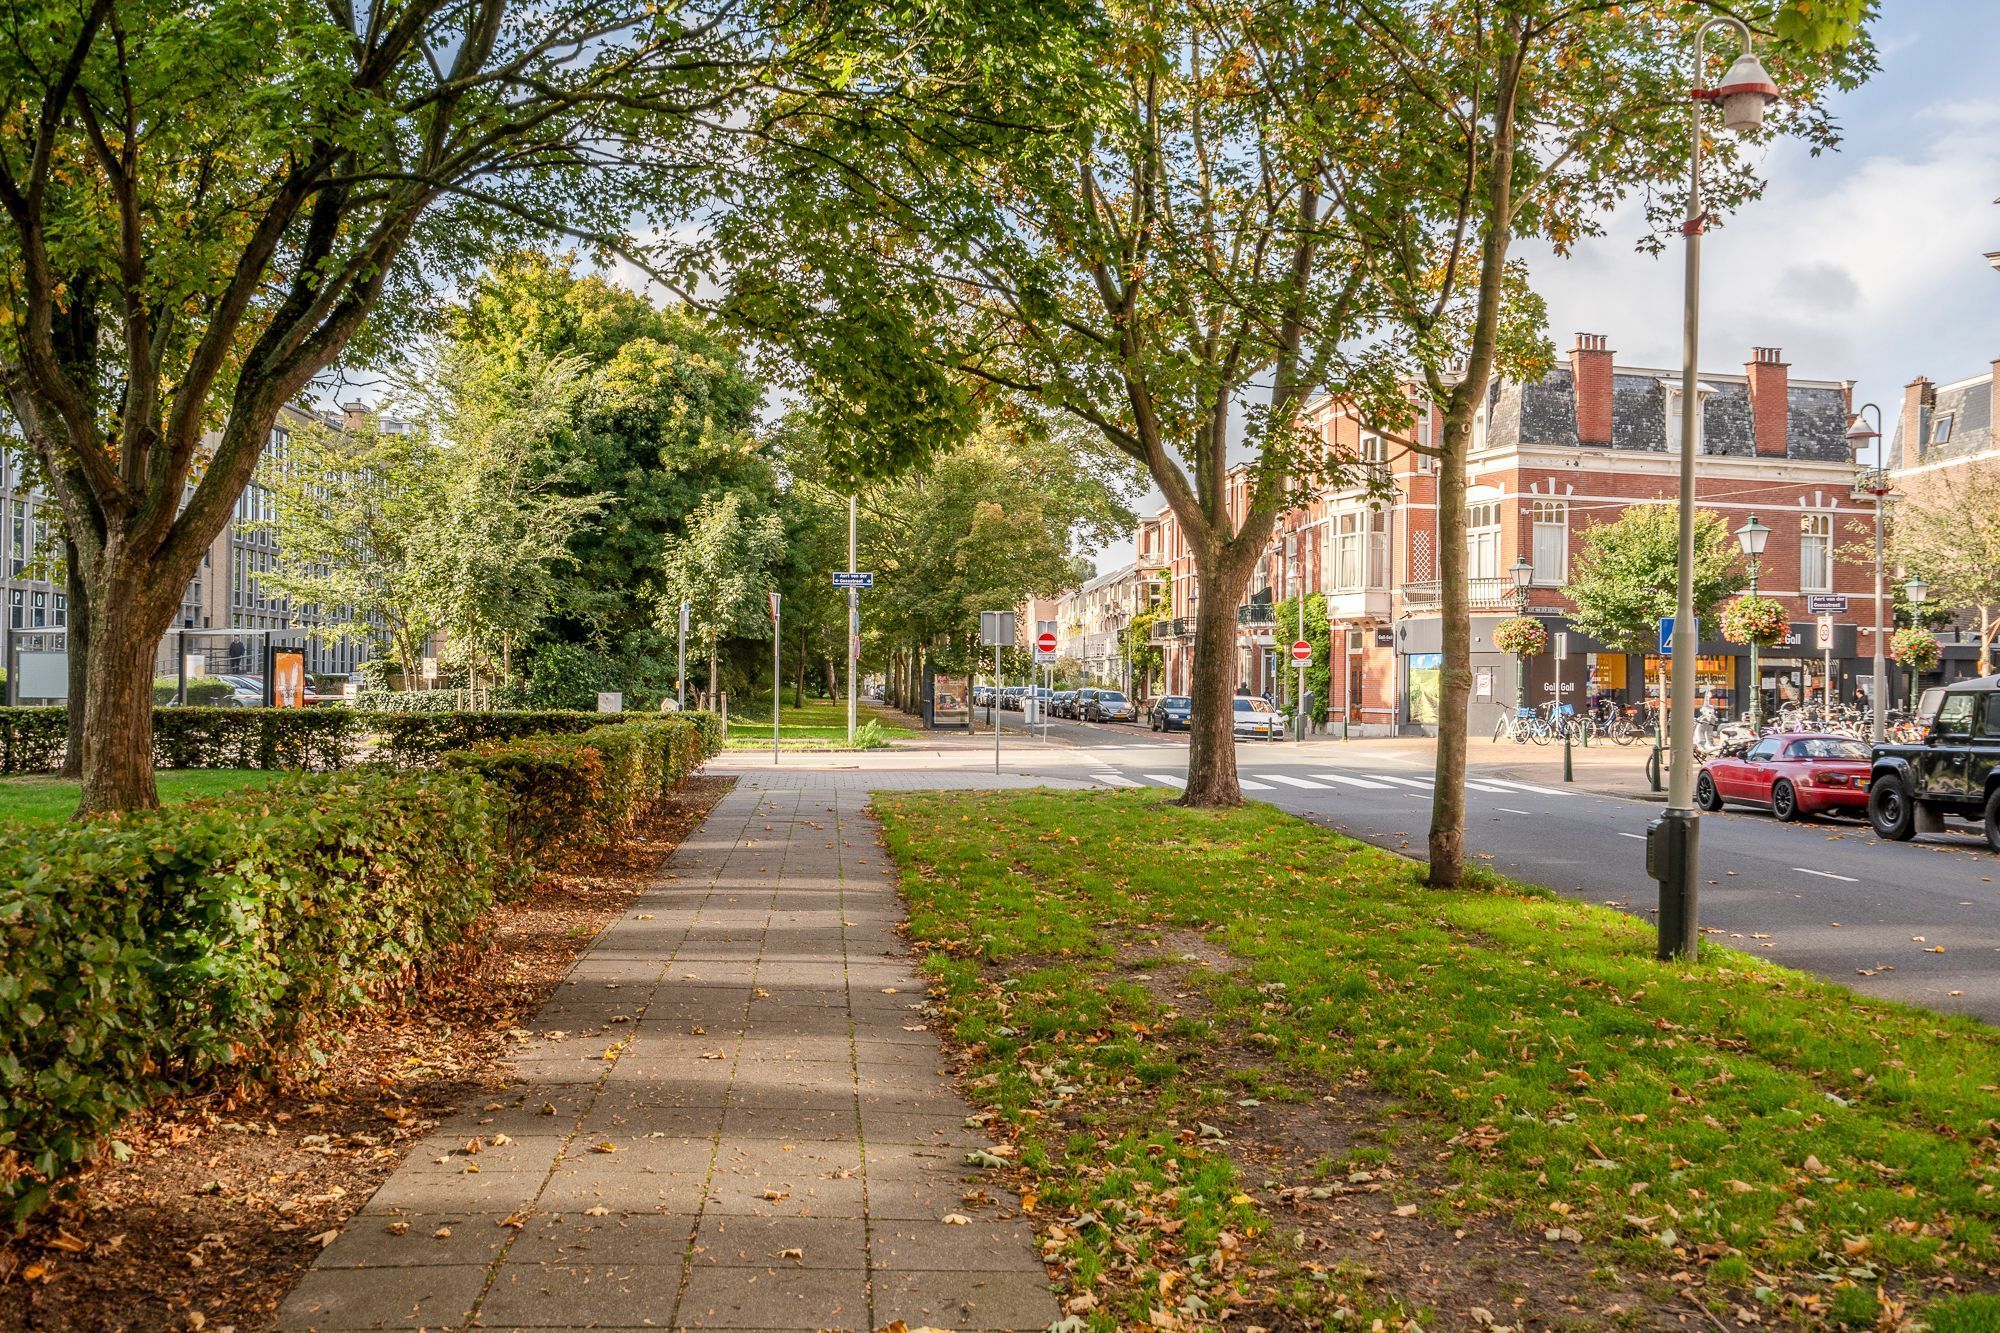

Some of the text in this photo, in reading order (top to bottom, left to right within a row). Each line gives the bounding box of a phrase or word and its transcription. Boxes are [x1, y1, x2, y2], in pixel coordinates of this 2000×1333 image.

[1784, 634, 1800, 644] Gall
[1544, 682, 1574, 692] Gal Gall
